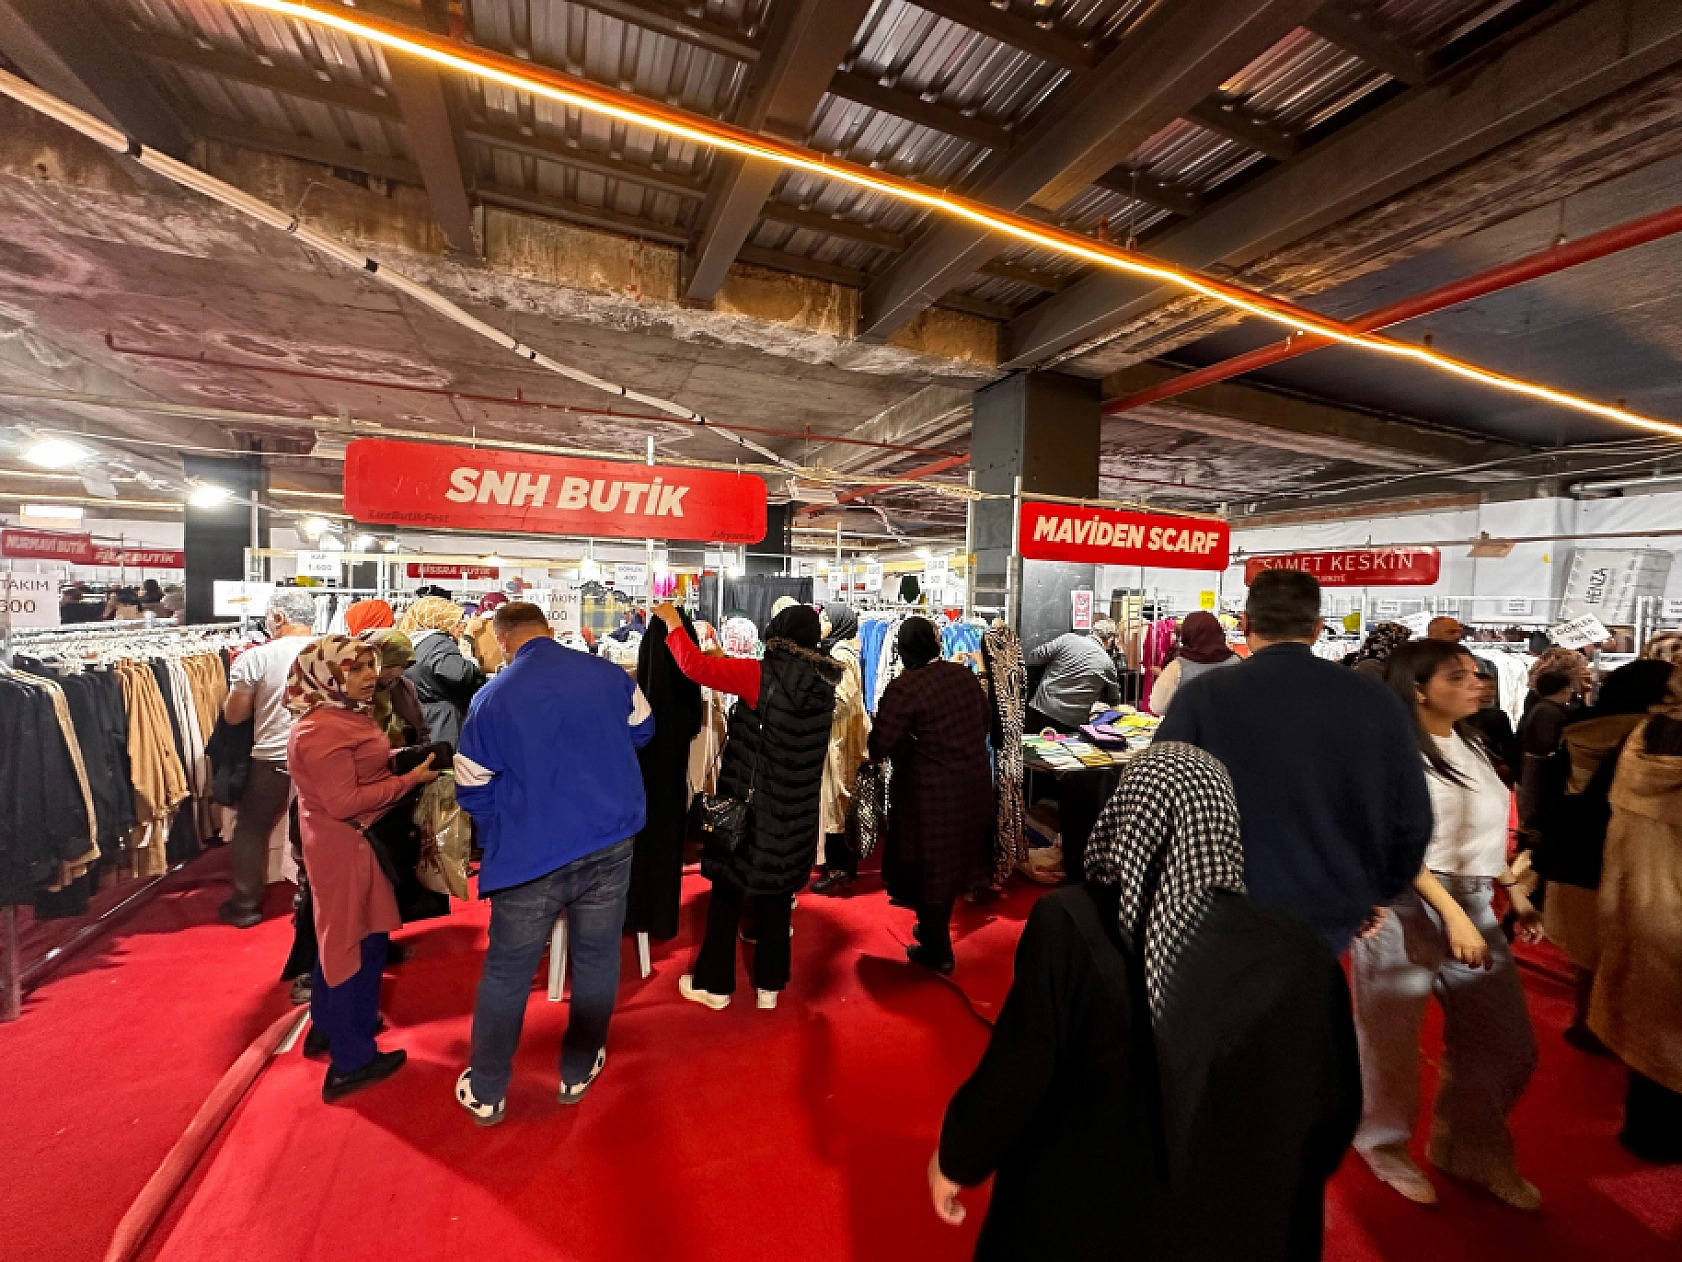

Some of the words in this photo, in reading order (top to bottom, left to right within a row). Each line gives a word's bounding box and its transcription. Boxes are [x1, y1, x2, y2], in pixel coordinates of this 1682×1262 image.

[445, 466, 550, 507] SNH
[556, 476, 690, 518] BUTİK
[1033, 514, 1146, 549] MAVİDEN
[1147, 525, 1220, 555] SCARF
[1263, 556, 1324, 572] SAMET
[1330, 553, 1414, 571] KESKİN
